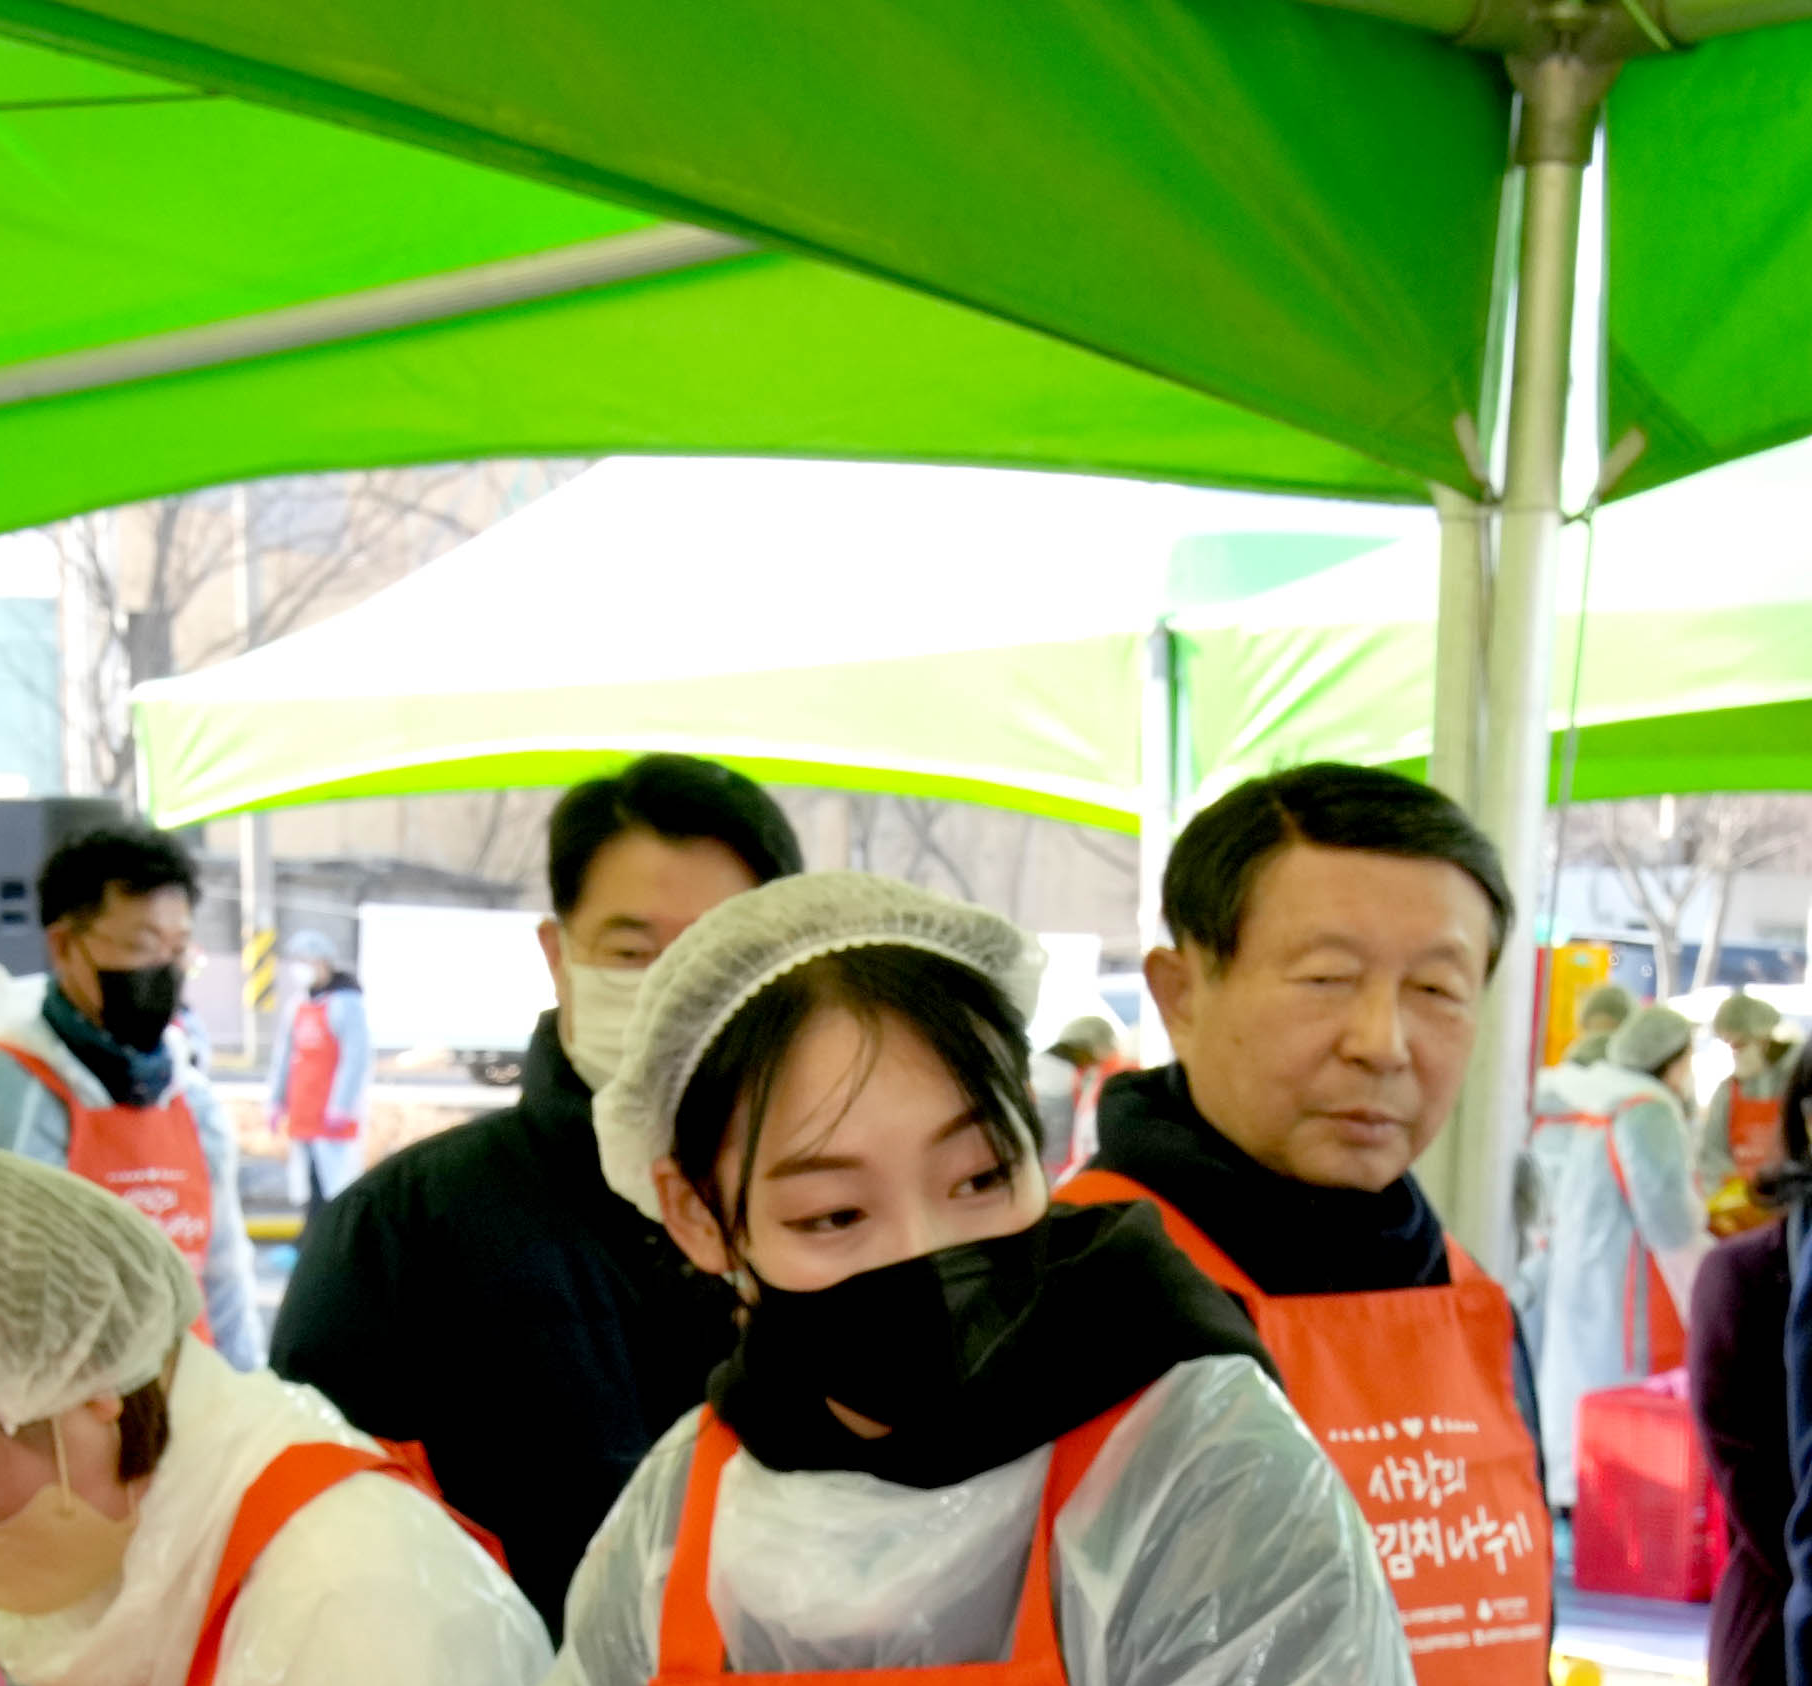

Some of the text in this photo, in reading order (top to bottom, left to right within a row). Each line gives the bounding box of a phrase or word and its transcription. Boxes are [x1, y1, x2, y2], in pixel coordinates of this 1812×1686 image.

[1368, 1449, 1466, 1508] 사랑의
[1372, 1504, 1534, 1580] 김치 나누기
